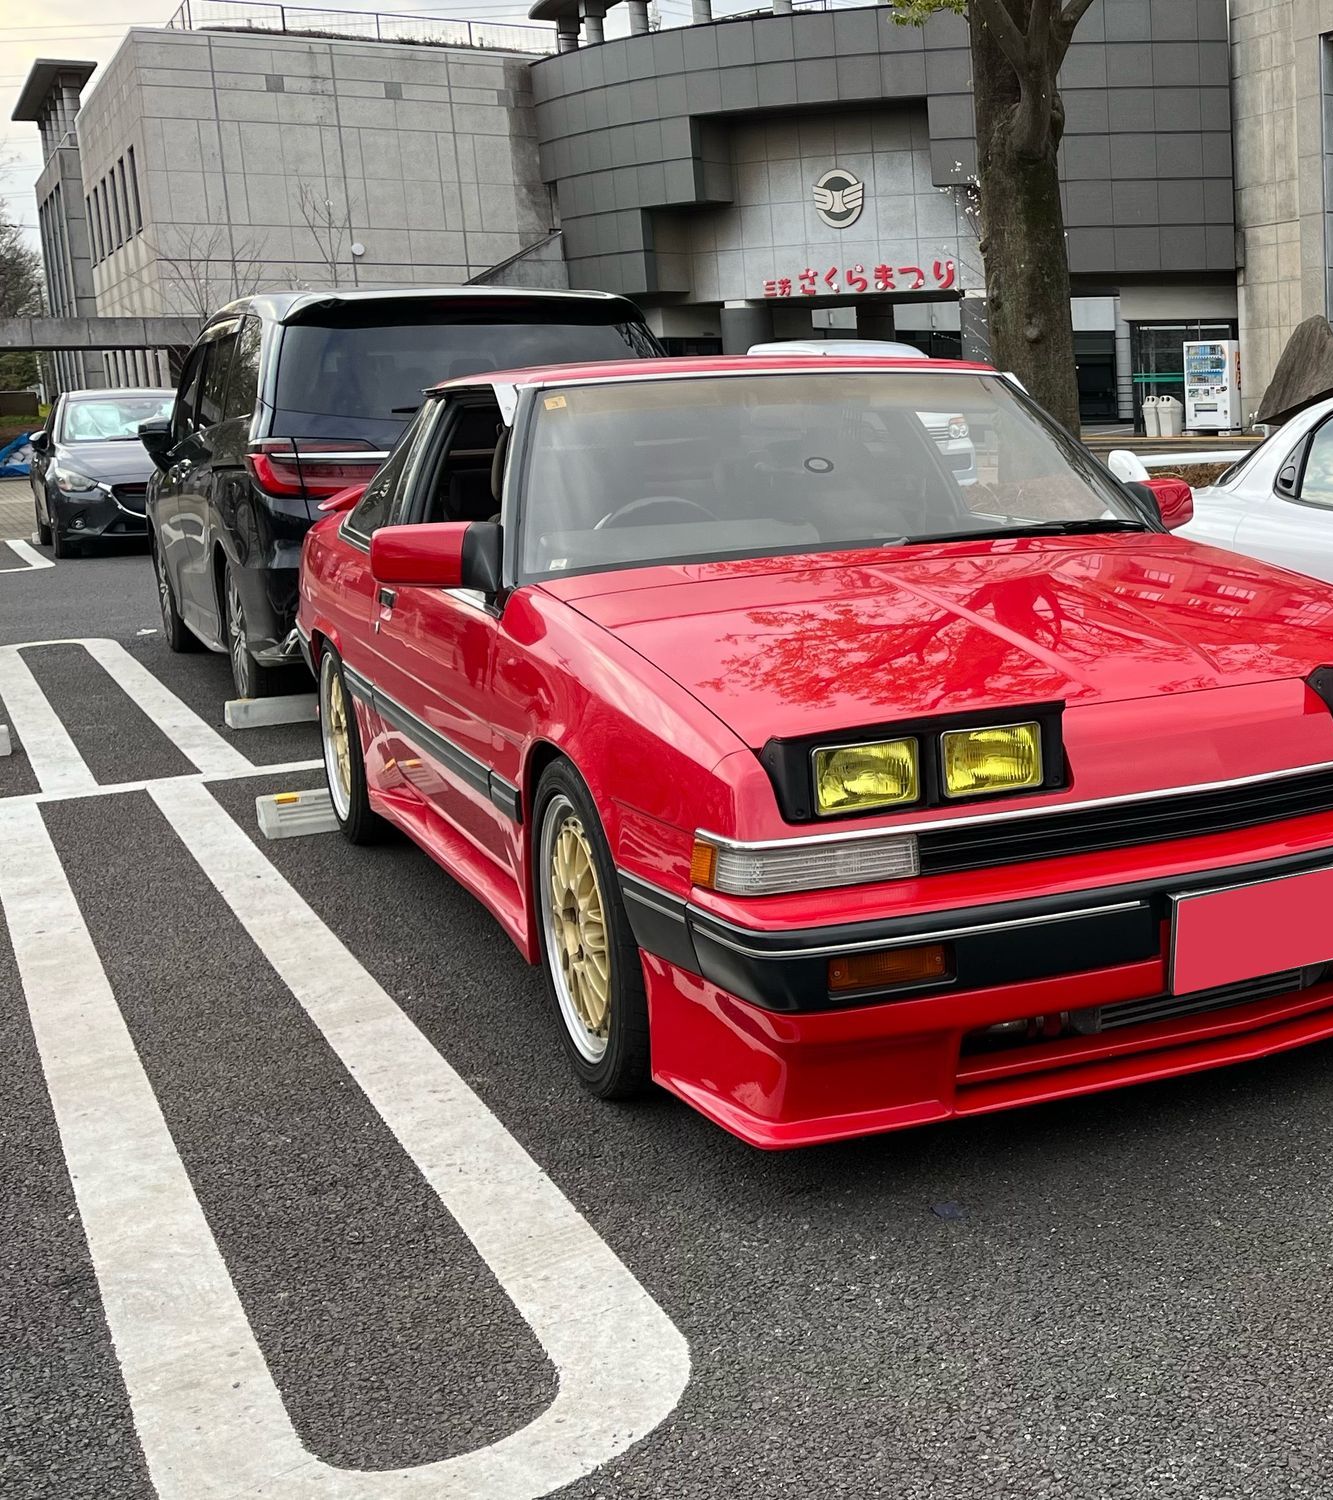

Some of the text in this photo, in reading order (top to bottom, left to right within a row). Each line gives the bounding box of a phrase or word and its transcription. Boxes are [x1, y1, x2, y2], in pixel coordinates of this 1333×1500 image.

[763, 260, 955, 296] 三芳 さくらまつり
